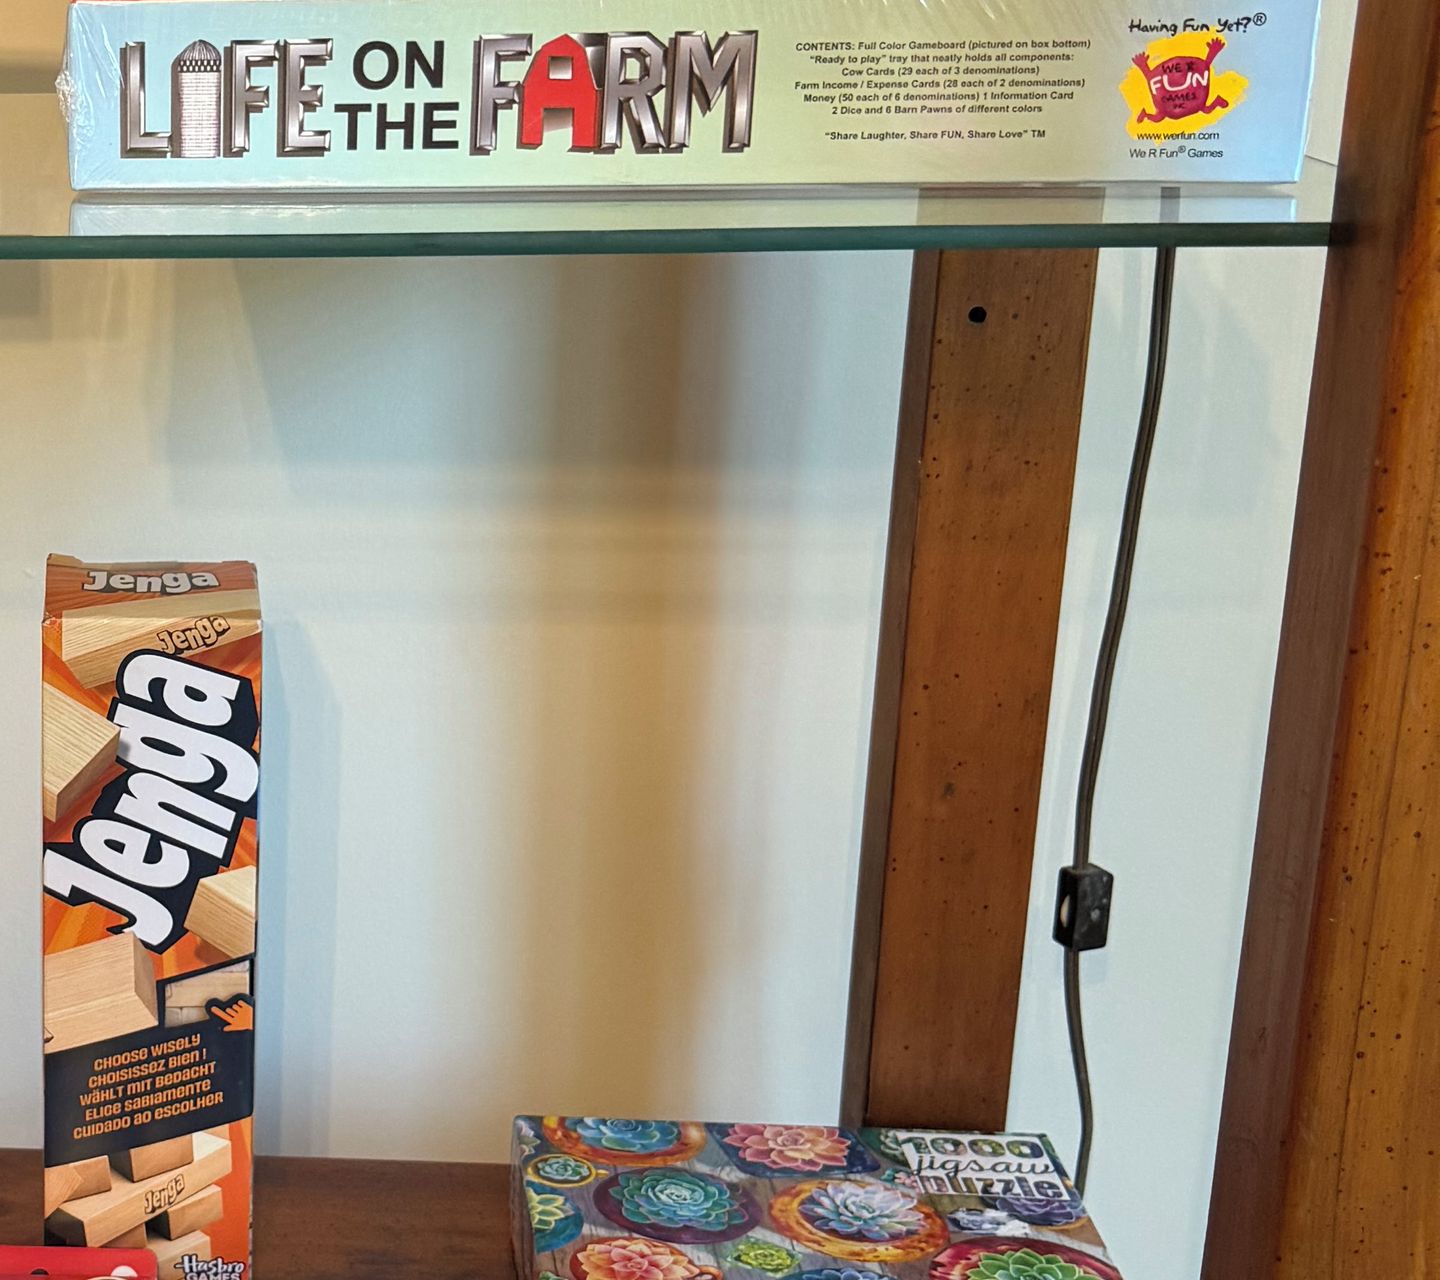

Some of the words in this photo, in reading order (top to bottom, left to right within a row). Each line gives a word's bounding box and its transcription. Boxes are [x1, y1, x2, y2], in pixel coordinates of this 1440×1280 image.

[795, 41, 856, 52] CONTENTS:
[858, 41, 877, 51] Full
[879, 41, 907, 51] Color
[909, 40, 966, 51] Gameboard
[968, 39, 1014, 51] (pictured
[1015, 41, 1028, 49] on
[1031, 39, 1050, 49] box
[1051, 39, 1091, 50] bottom)
[353, 40, 445, 91] ON
[470, 29, 759, 157] FARM
[1149, 70, 1209, 95] FUN
[334, 103, 460, 151] THE
[1129, 148, 1146, 158] We
[1148, 148, 1157, 158] R
[1187, 148, 1224, 158] Games
[82, 569, 221, 595] Jenga
[156, 614, 231, 657] Jenga
[41, 652, 260, 951] Jenga
[900, 1136, 1044, 1159] 1000
[913, 1154, 1058, 1176] jigsaw
[143, 1173, 185, 1215] Jenga
[914, 1172, 1064, 1199] puzzle
[173, 1254, 245, 1274] Hasbro
